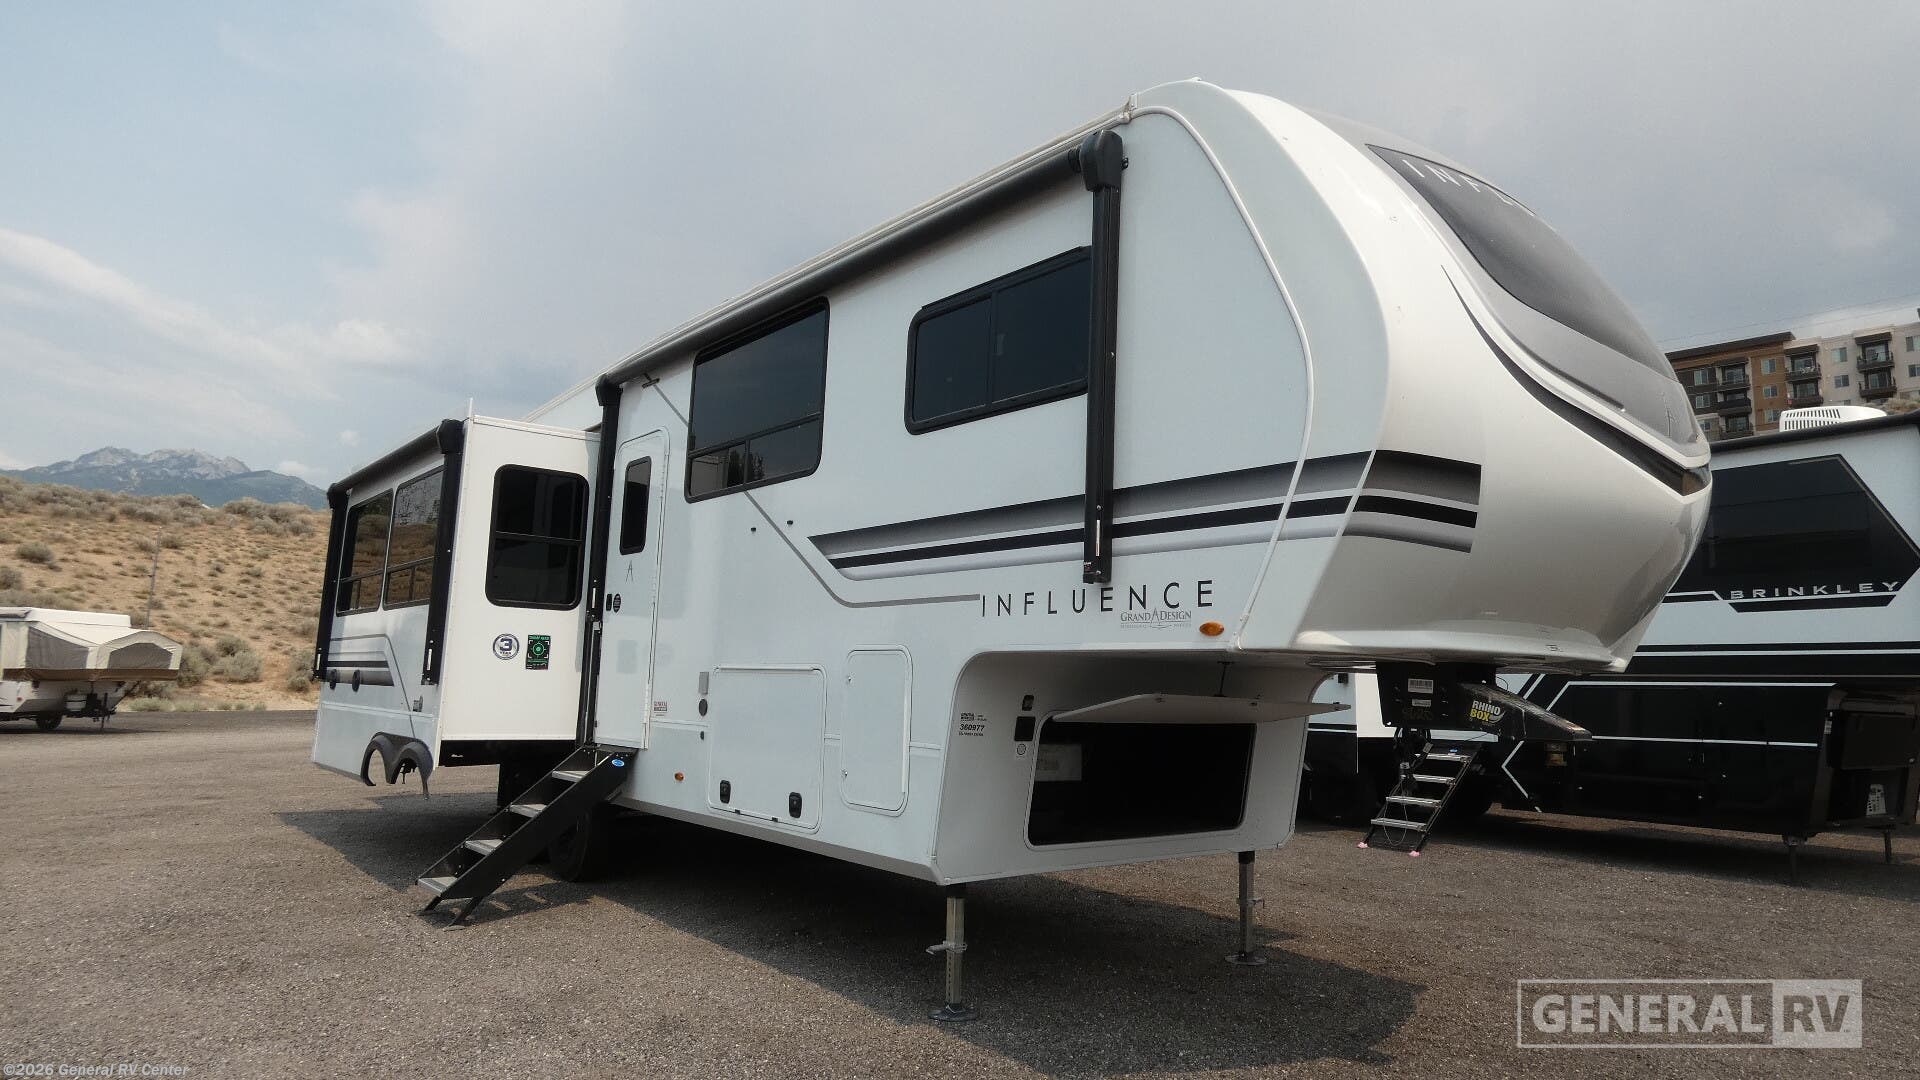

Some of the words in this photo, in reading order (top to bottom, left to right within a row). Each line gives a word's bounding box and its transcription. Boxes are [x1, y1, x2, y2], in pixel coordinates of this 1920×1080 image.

[1730, 581, 1898, 600] BRINKLEY
[982, 580, 1213, 617] INFLUENCE
[500, 638, 512, 651] 3
[1470, 709, 1490, 721] BOX
[1472, 700, 1501, 715] RHINO
